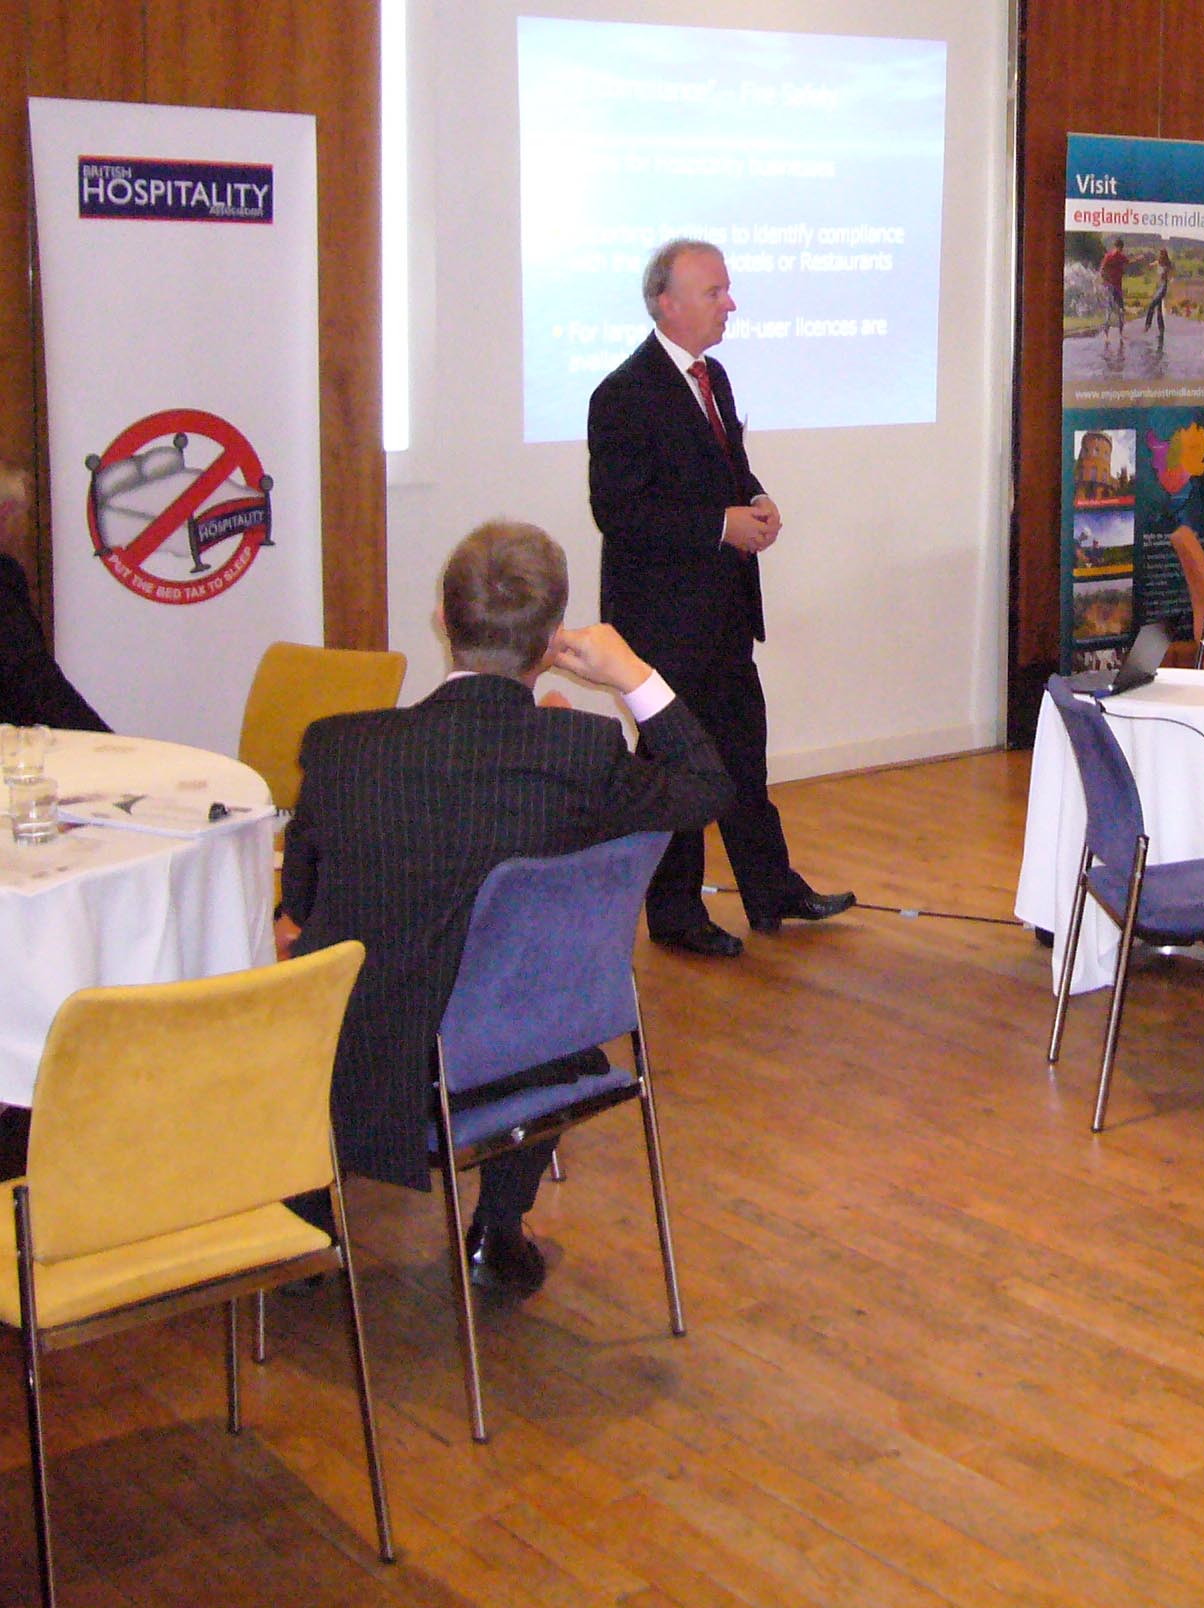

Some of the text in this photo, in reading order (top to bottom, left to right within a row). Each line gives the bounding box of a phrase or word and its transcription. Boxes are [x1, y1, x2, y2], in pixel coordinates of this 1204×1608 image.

[83, 165, 132, 178] BRITISH
[83, 178, 269, 207] HOSPITALITY
[1076, 173, 1118, 195] Visit
[817, 224, 906, 248] compliance
[777, 254, 797, 272] or
[800, 251, 893, 272] Restaurants
[725, 317, 792, 339] ulti-user
[795, 316, 858, 337] licences
[861, 318, 888, 336] are
[199, 510, 264, 542] HOSPITALITY
[108, 554, 132, 578] PUT
[156, 585, 181, 600] BED
[207, 577, 224, 592] TO
[223, 546, 252, 582] SLEEP
